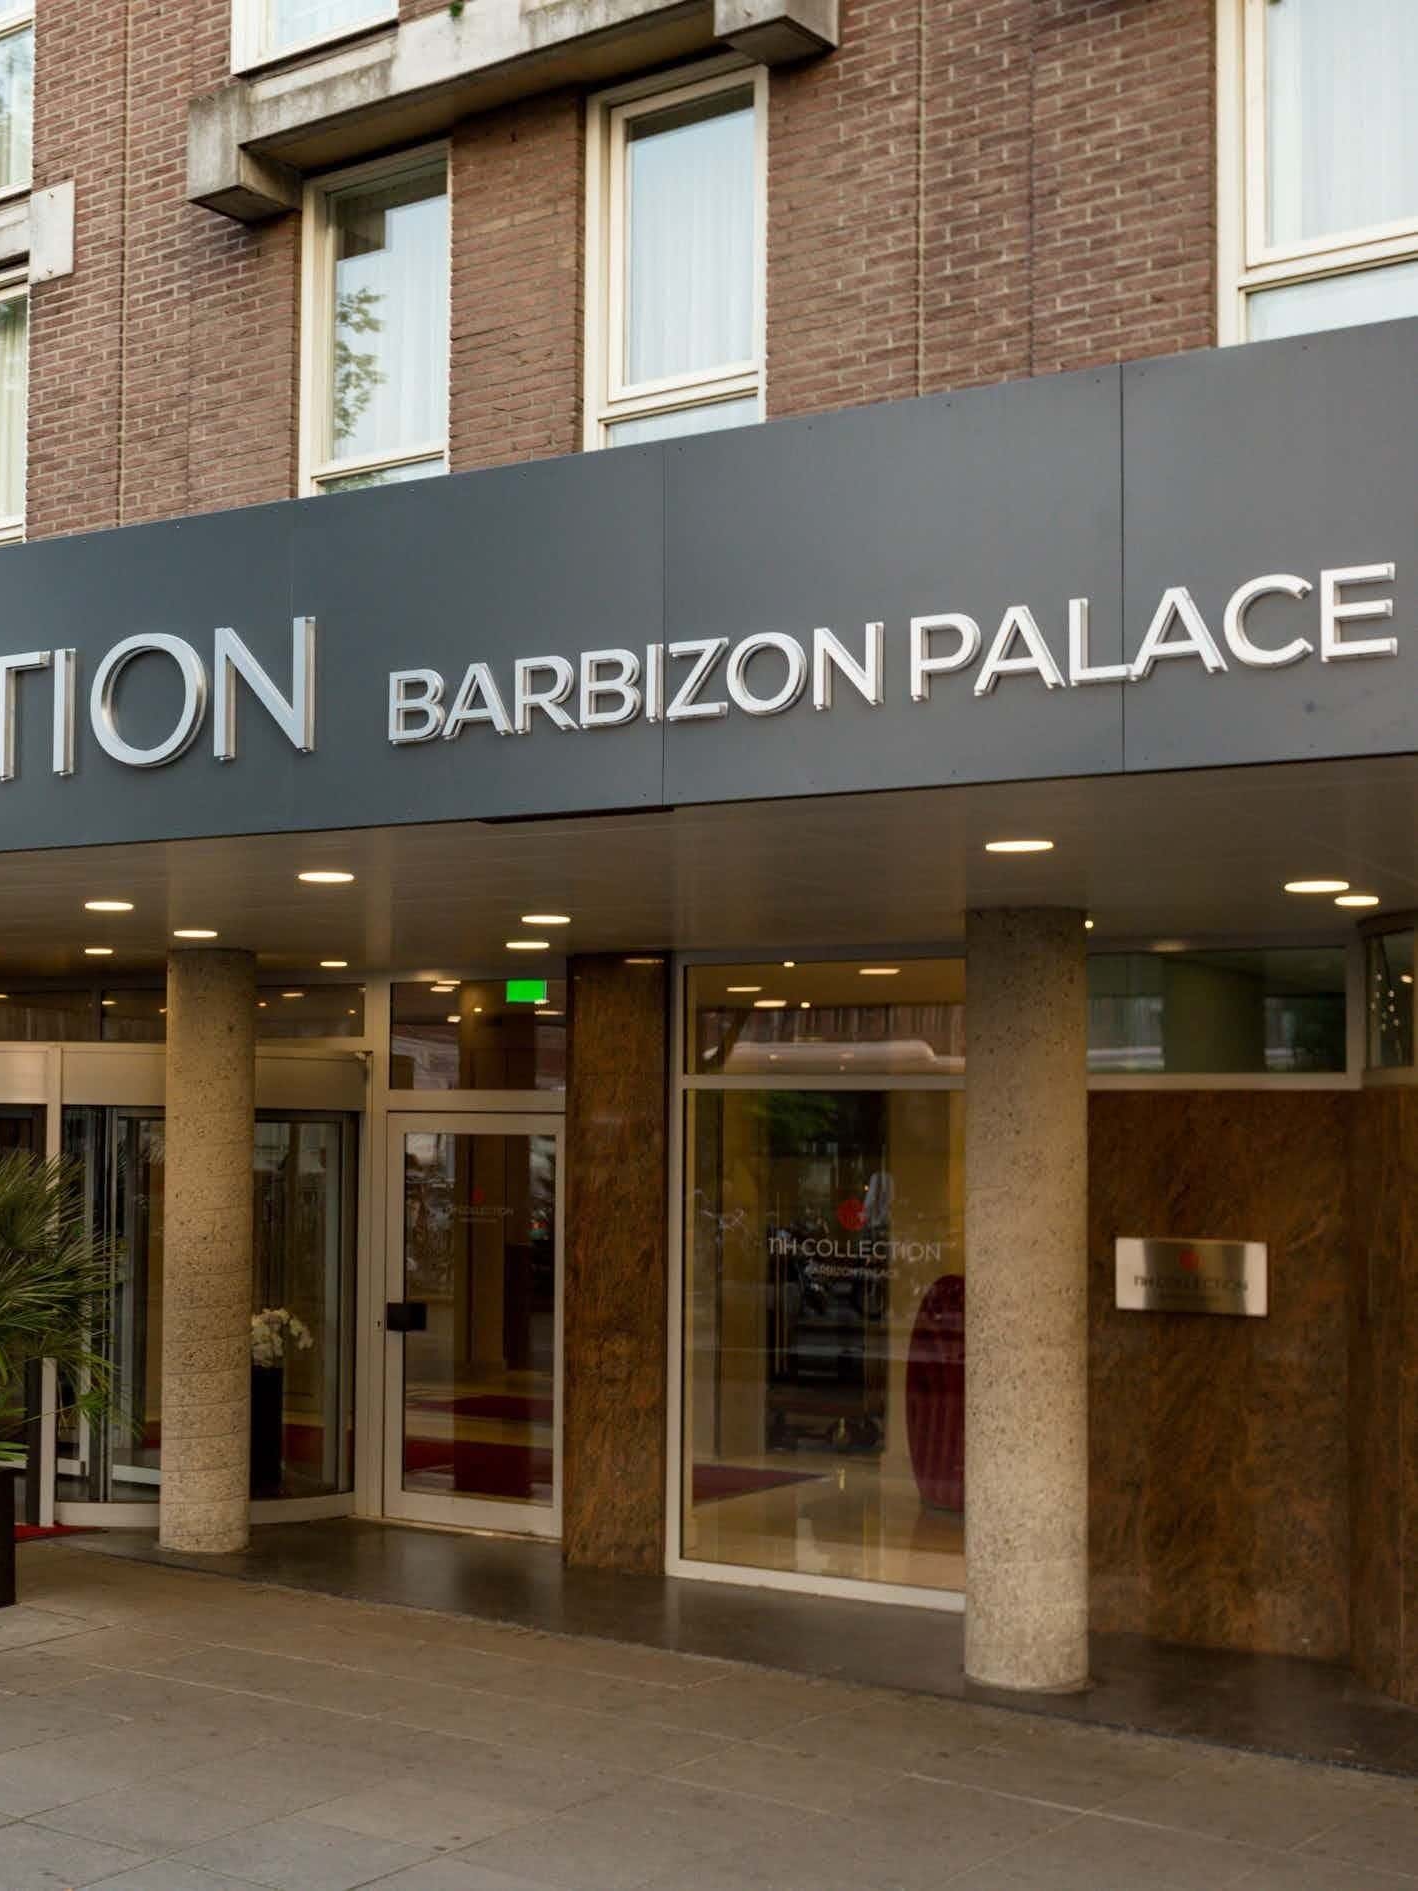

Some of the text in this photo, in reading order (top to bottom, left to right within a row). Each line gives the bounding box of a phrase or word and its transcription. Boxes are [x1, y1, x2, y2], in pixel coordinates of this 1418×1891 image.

[389, 622, 884, 746] BARBIZON
[910, 562, 1397, 701] PALACE
[801, 1238, 941, 1262] COLLECTION
